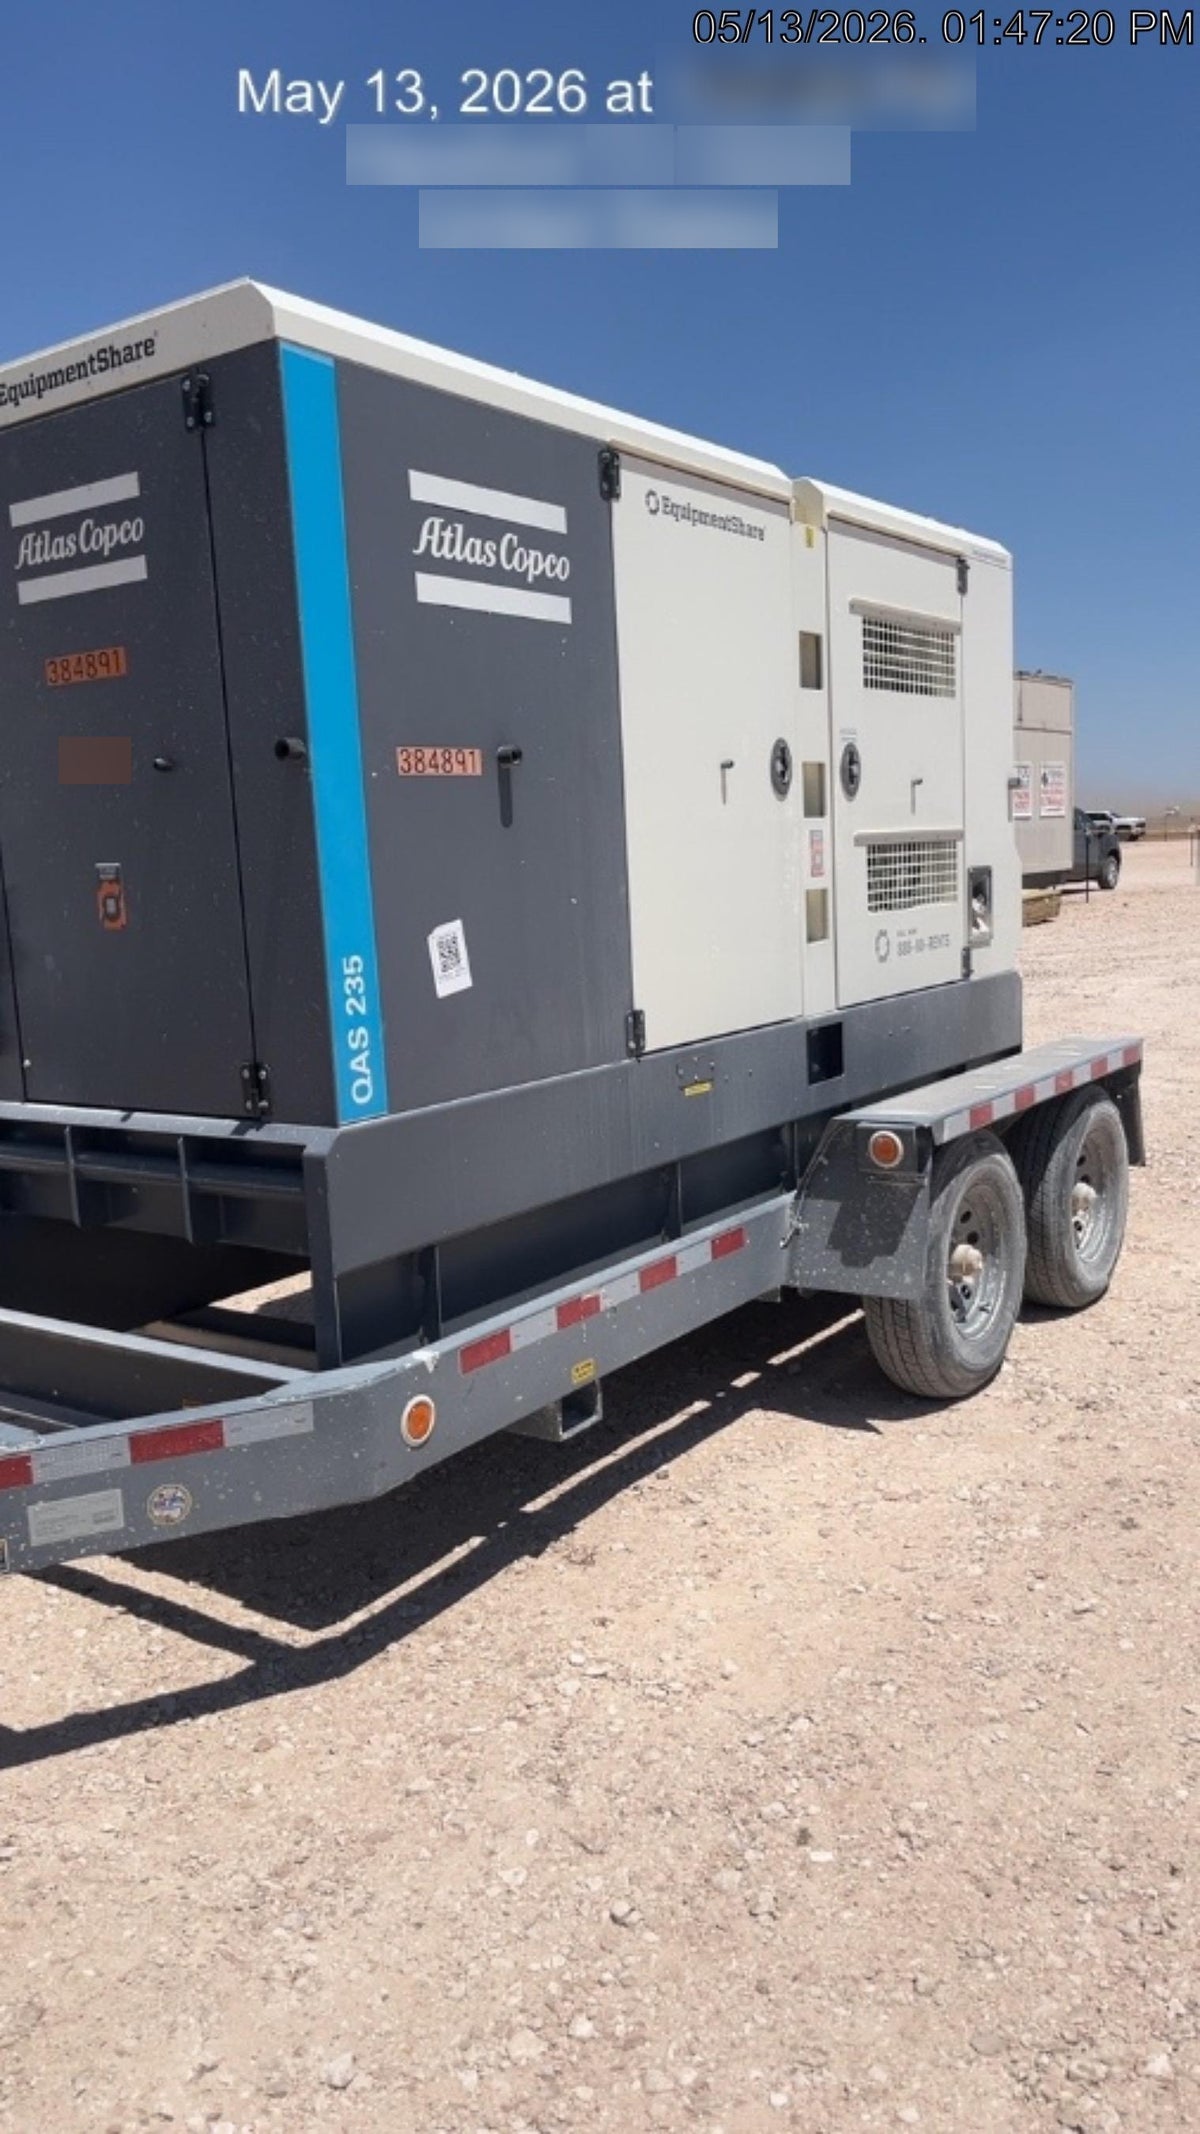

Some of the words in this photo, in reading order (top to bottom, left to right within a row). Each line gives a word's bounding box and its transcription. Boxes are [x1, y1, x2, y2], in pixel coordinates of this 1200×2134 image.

[661, 494, 765, 541] EquipmentShare
[47, 649, 122, 685] 384891
[399, 748, 478, 775] 384891
[342, 954, 367, 1016] 235
[347, 1026, 374, 1105] QAS
